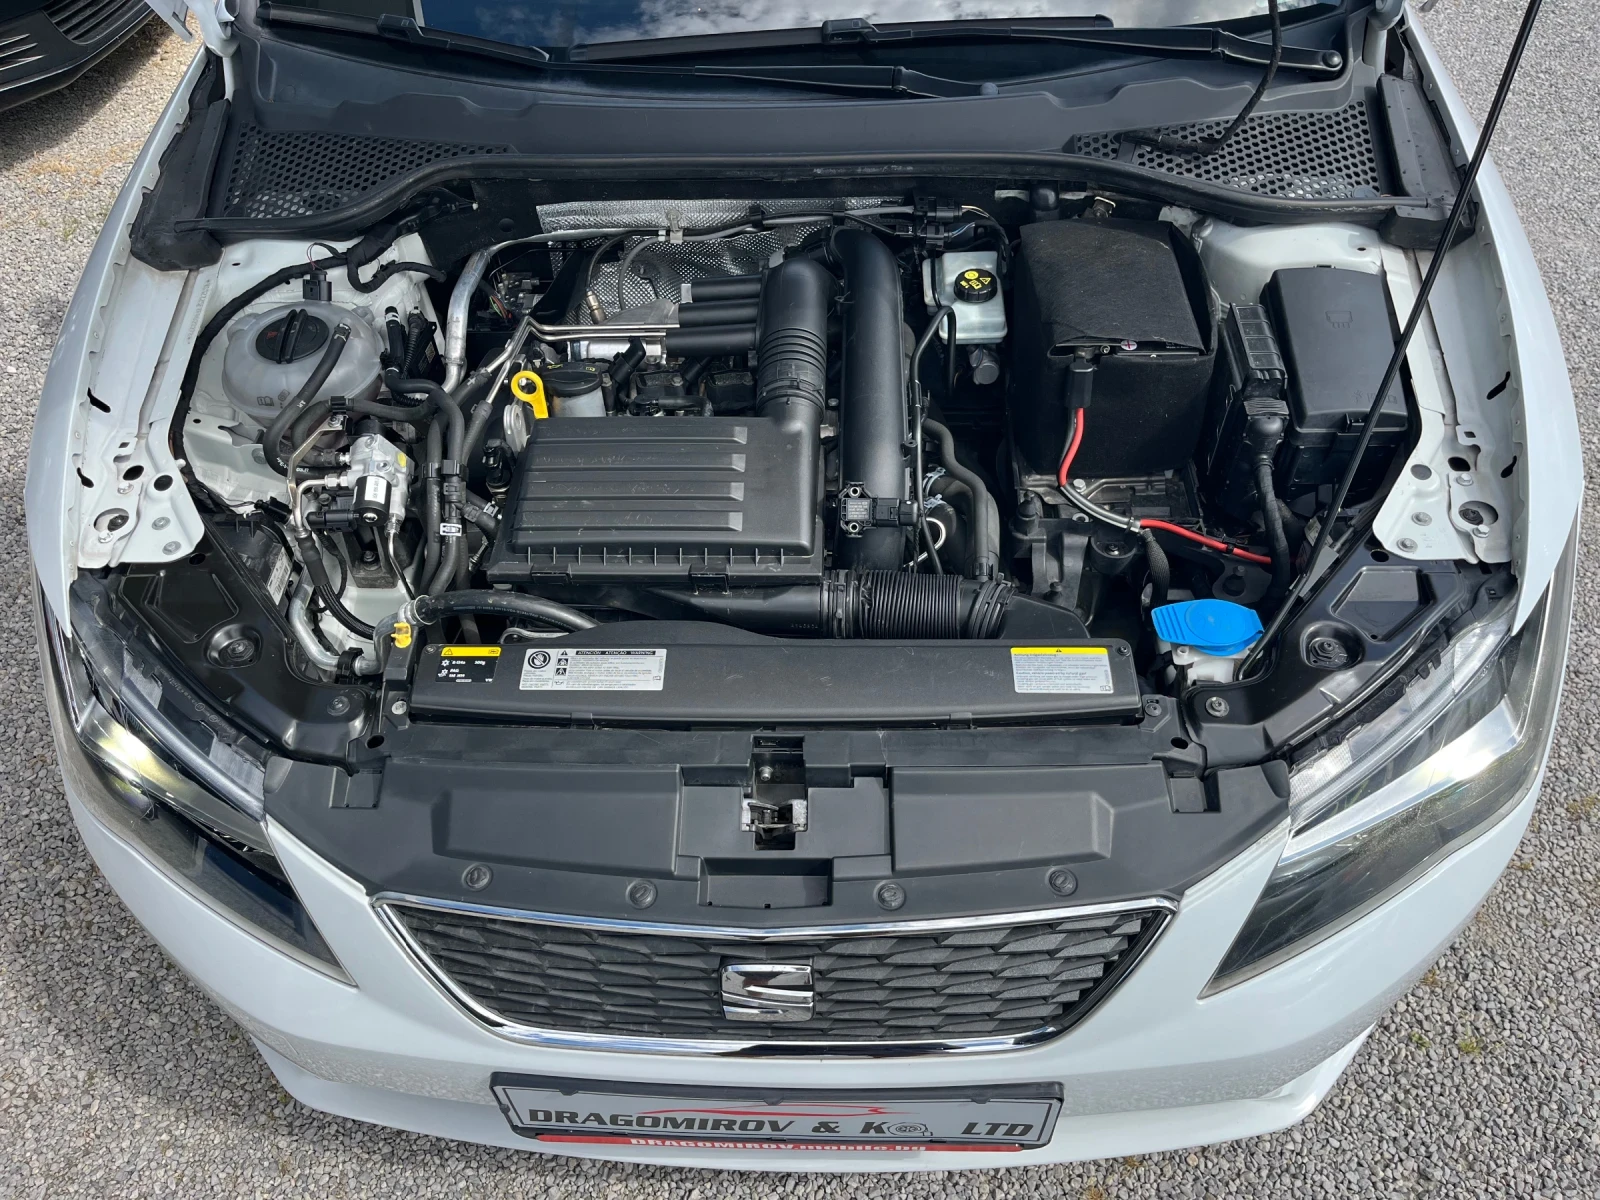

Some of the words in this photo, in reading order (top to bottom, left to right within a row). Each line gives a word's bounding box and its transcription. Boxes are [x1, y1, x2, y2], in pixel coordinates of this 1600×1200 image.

[529, 1109, 795, 1131] DRAGOMIROV
[812, 1121, 840, 1133] &
[860, 1121, 888, 1134] K
[961, 1122, 1034, 1137] LTD
